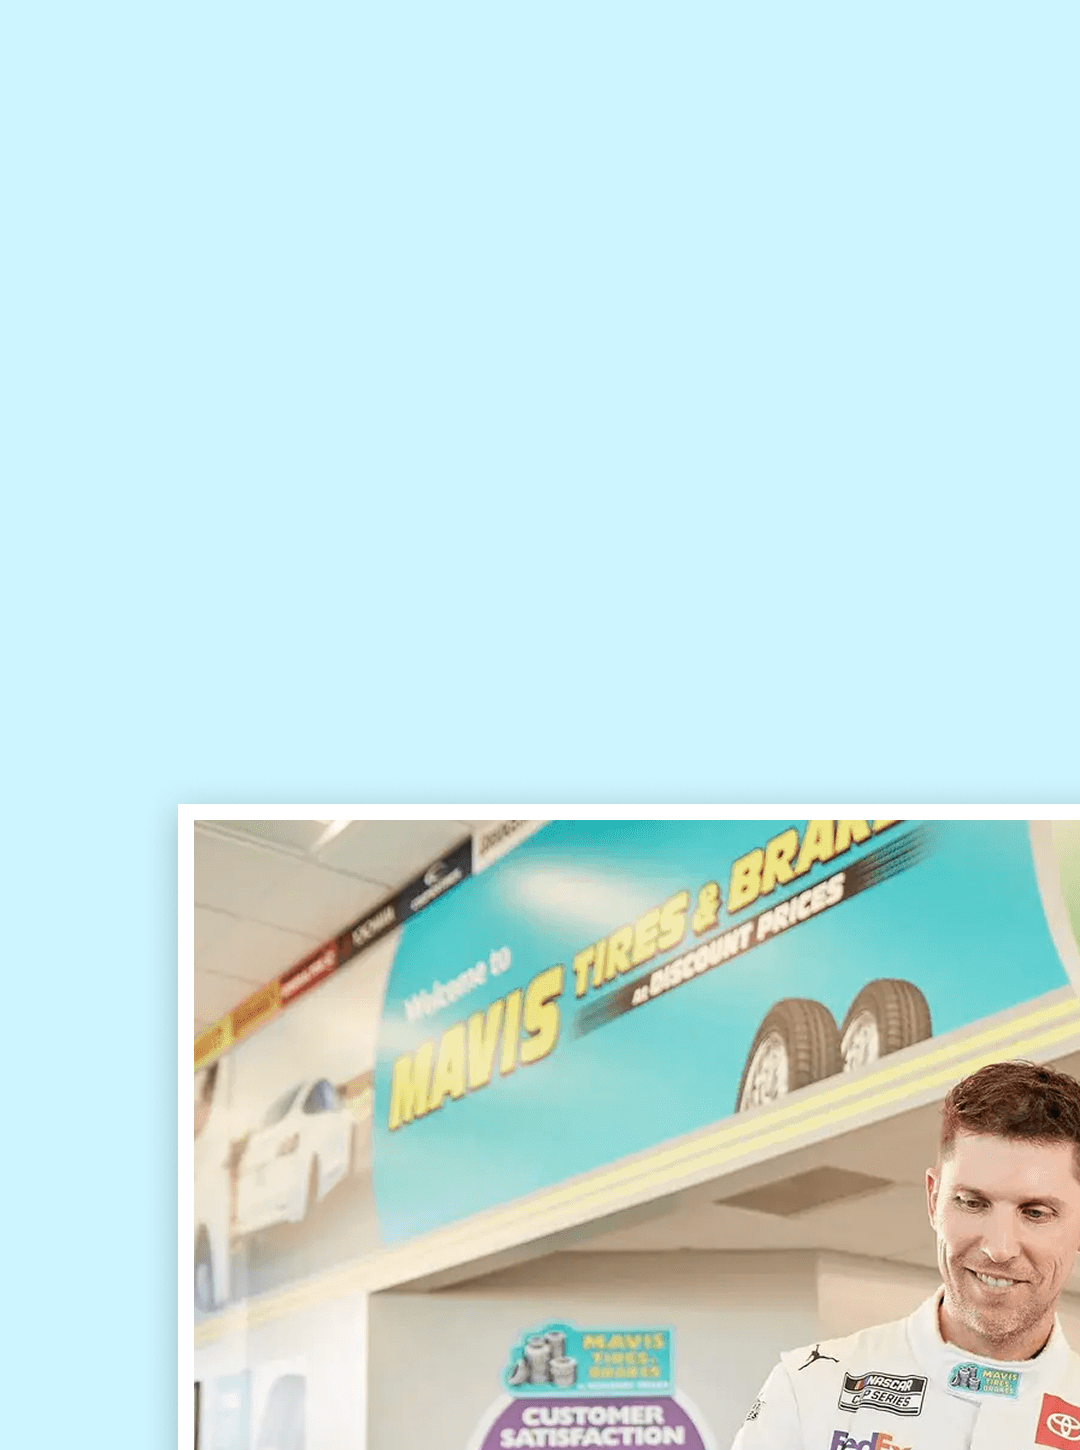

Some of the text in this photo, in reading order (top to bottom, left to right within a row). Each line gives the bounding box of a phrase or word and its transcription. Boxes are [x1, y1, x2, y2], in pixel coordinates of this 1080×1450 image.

[573, 890, 690, 998] TIRES
[692, 881, 722, 937] &
[650, 921, 754, 997] DISCOUNT
[756, 872, 846, 941] PRICES
[490, 947, 511, 976] to
[388, 963, 566, 1131] MAVIS
[582, 1333, 665, 1350] MAVIS
[866, 1375, 913, 1391] NASCAR
[983, 1369, 1018, 1381] MAVIS
[871, 1391, 911, 1407] SERIES
[521, 1405, 666, 1426] CUSTOMER
[500, 1426, 686, 1447] SATISFACTION
